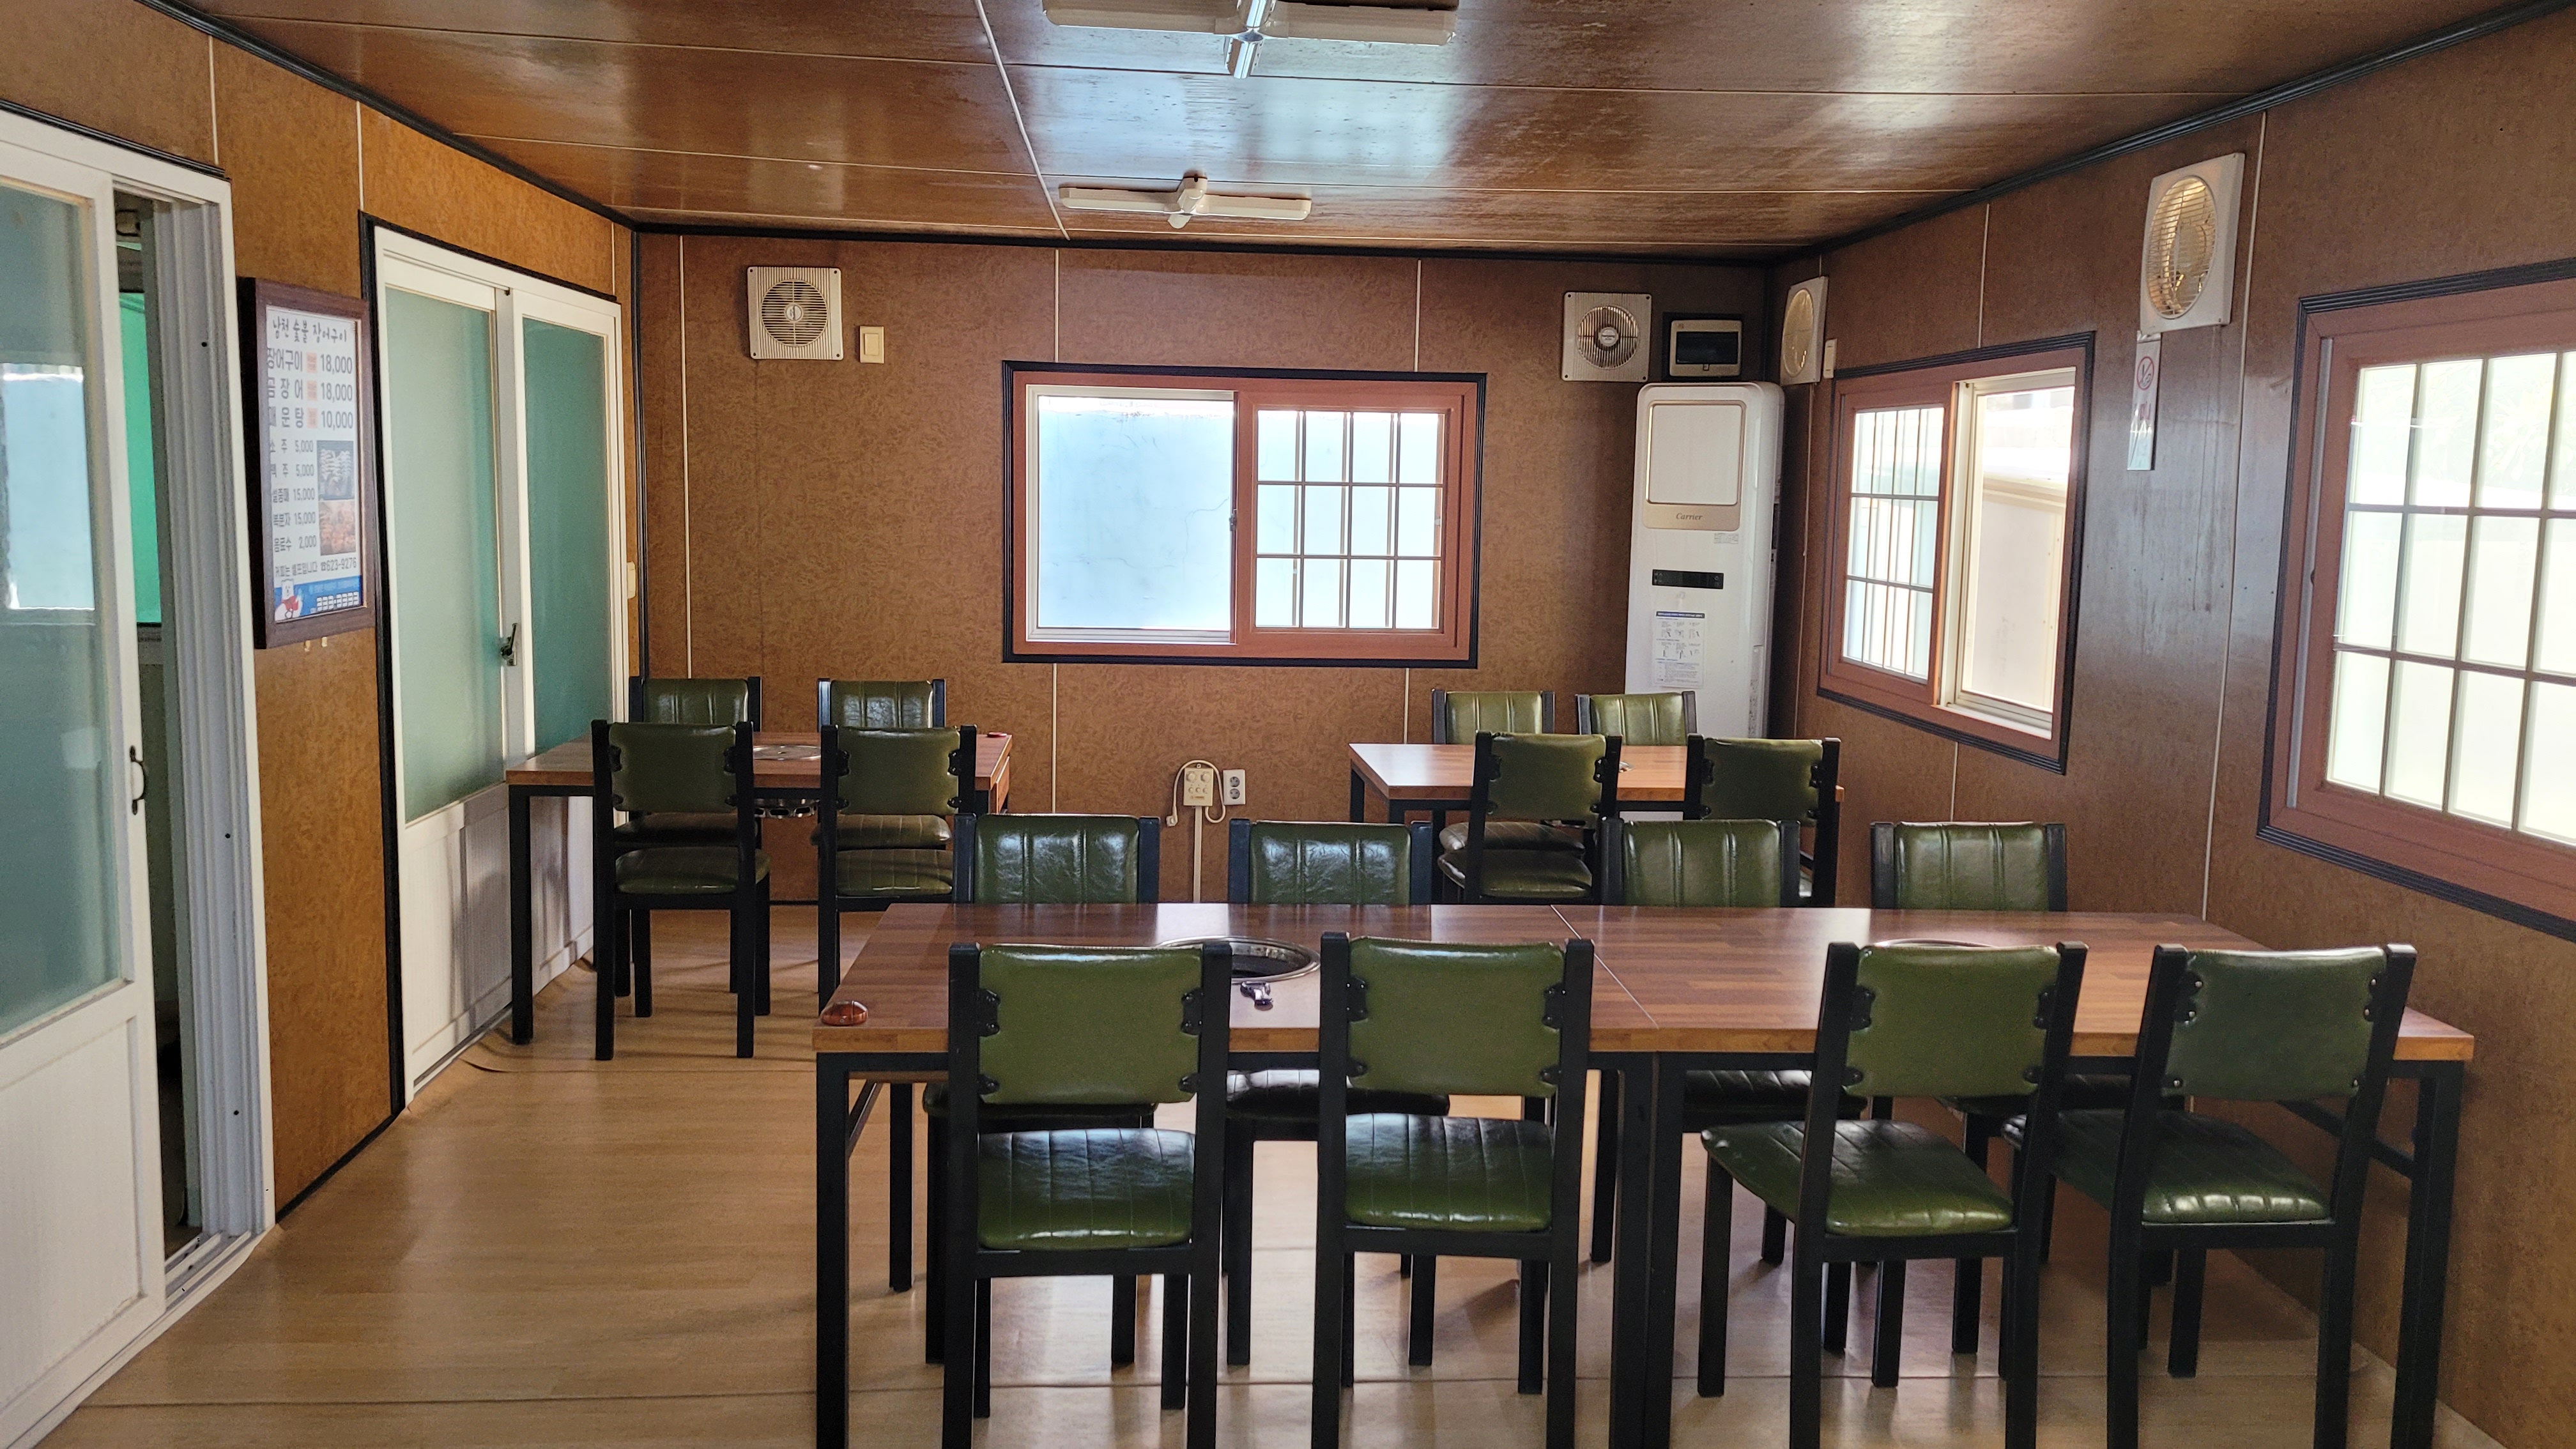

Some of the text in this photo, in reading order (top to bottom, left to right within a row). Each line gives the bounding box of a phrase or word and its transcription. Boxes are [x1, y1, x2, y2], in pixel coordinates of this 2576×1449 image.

[273, 316, 347, 343] 남천 숯불 장어구이
[267, 348, 303, 372] 장어구이
[320, 353, 353, 375] 18,000
[321, 382, 353, 402] 18,000
[321, 410, 353, 431] 10,000
[295, 440, 314, 454] 5,000
[296, 464, 314, 477] 5,000
[293, 487, 315, 501] 15,000
[294, 511, 316, 525] 15,000
[298, 535, 317, 549] 2,000
